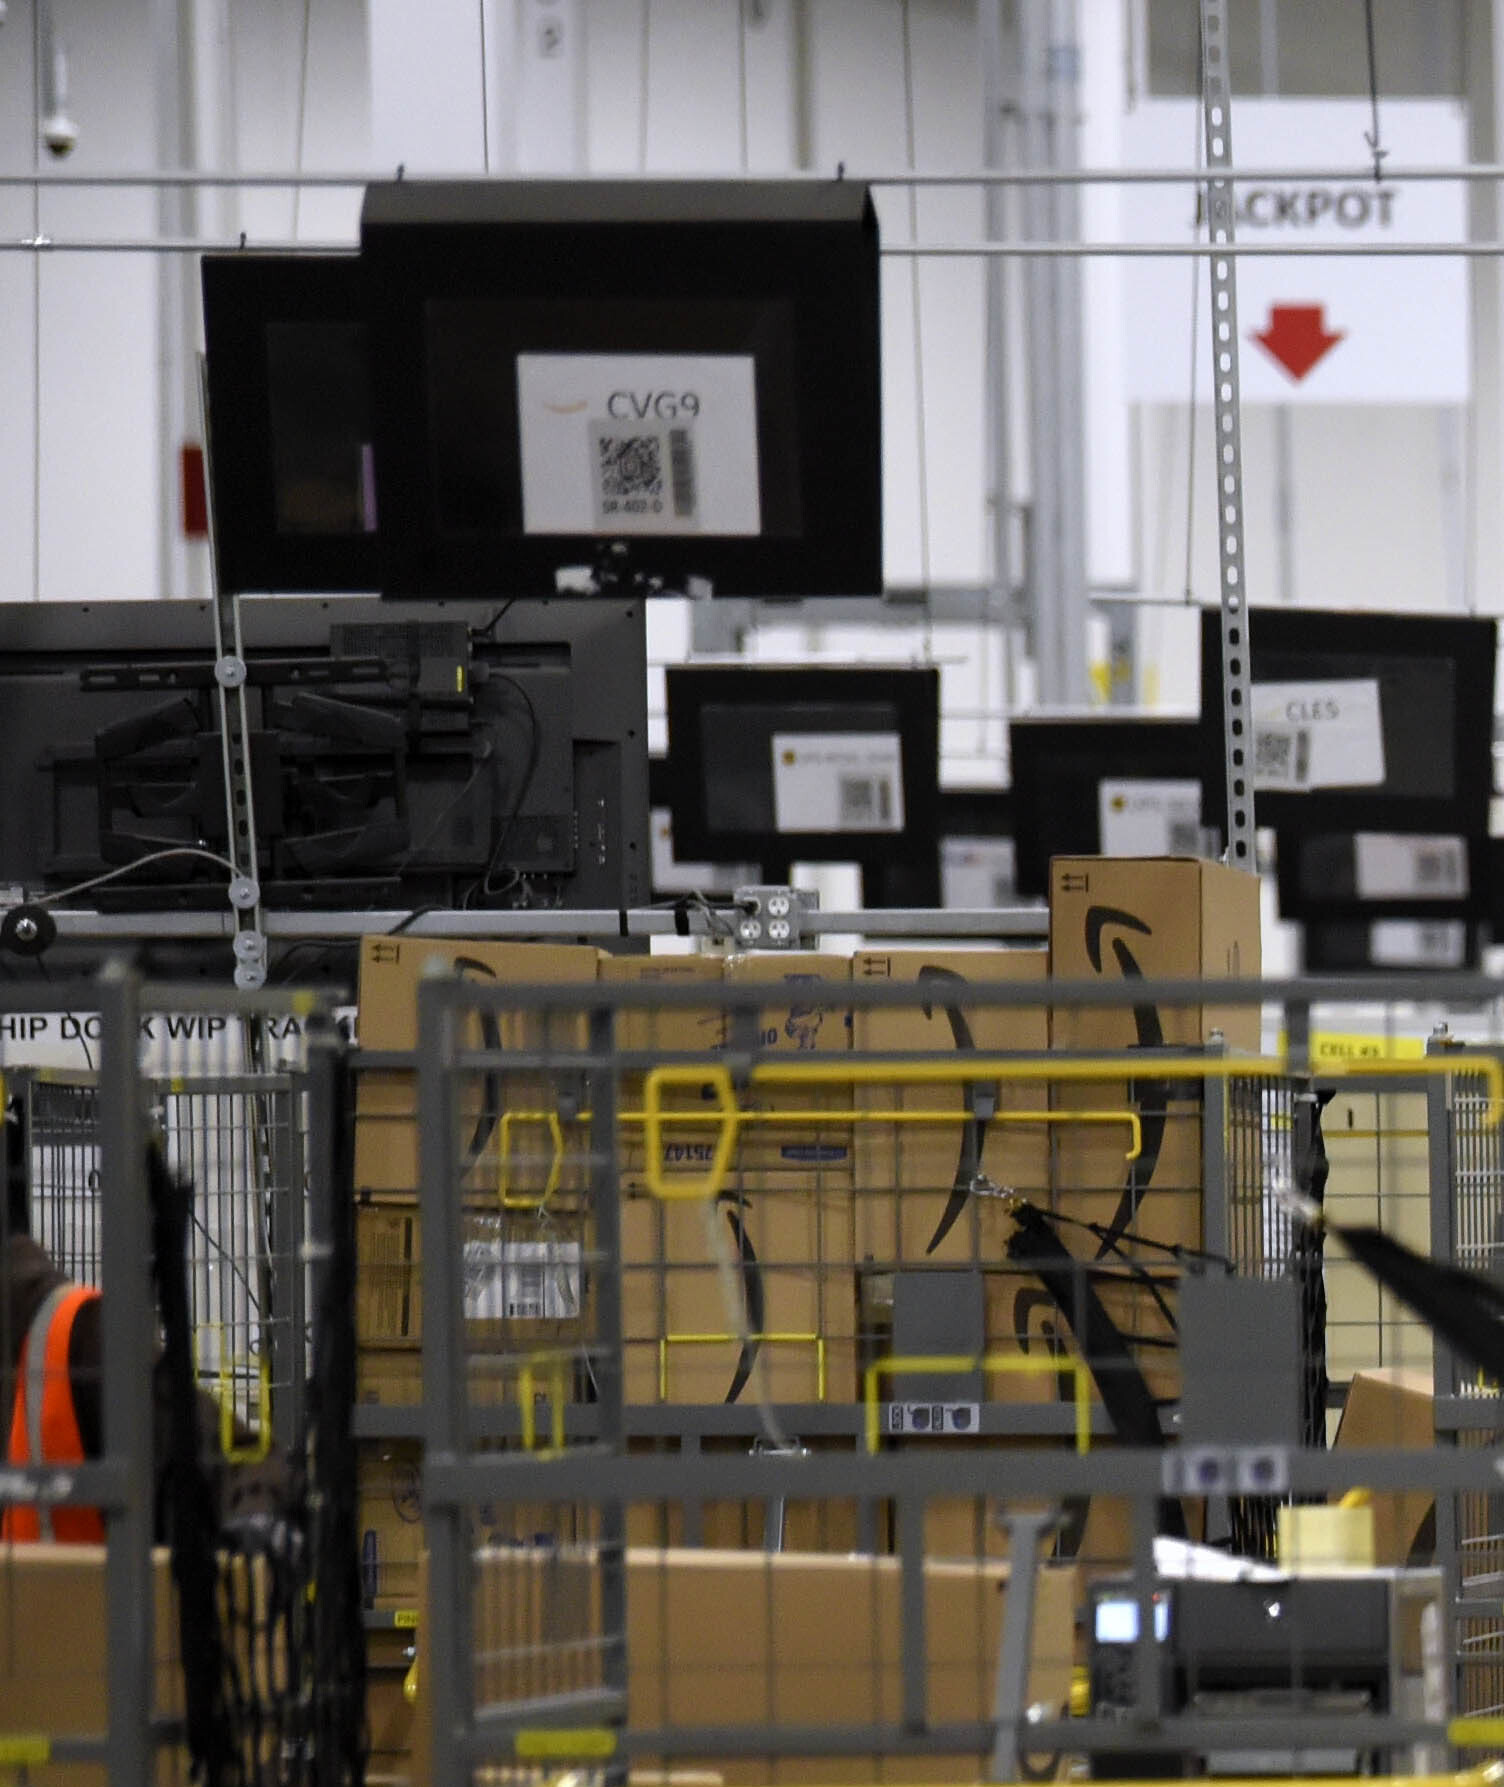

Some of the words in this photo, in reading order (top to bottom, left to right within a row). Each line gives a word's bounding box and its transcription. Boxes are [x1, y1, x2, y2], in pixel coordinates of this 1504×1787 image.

[1191, 189, 1398, 228] JCKPOT
[607, 391, 700, 420] CVG9
[0, 1016, 48, 1040] HIP
[60, 1016, 155, 1040] DOK
[167, 1016, 226, 1040] WIP
